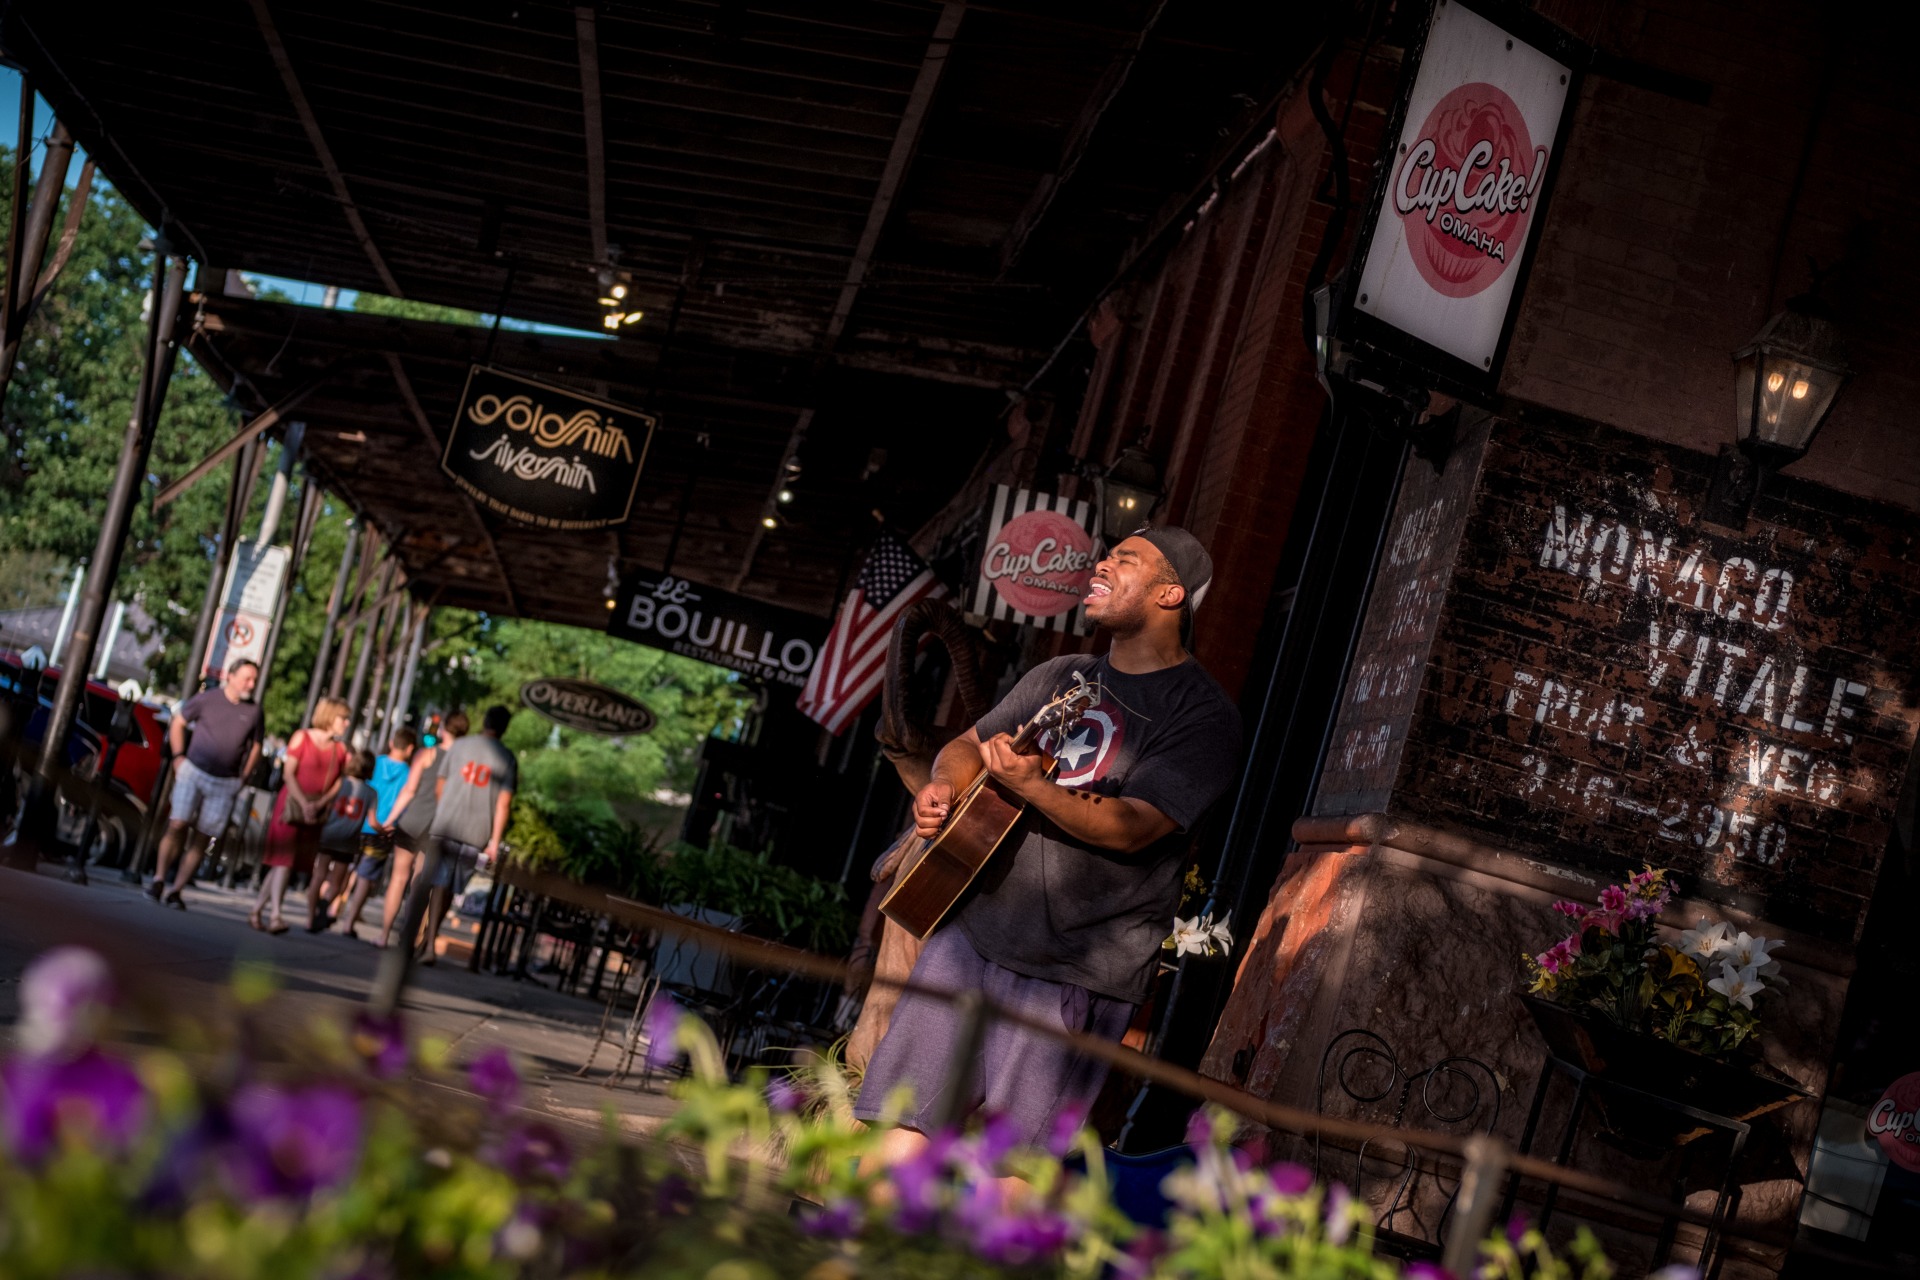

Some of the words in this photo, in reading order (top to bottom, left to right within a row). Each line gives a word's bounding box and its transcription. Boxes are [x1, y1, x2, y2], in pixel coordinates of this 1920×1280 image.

[1396, 138, 1546, 223] CupCake!
[1439, 212, 1505, 262] OMAHA
[984, 537, 1101, 582] CupCake!
[1538, 503, 1797, 632] MONACO
[1023, 576, 1081, 596] OMAHA
[626, 593, 825, 675] BOUILLO
[672, 640, 761, 677] RESTAURANT
[529, 680, 649, 729] OVERLAND
[1647, 619, 1869, 746] VITALE
